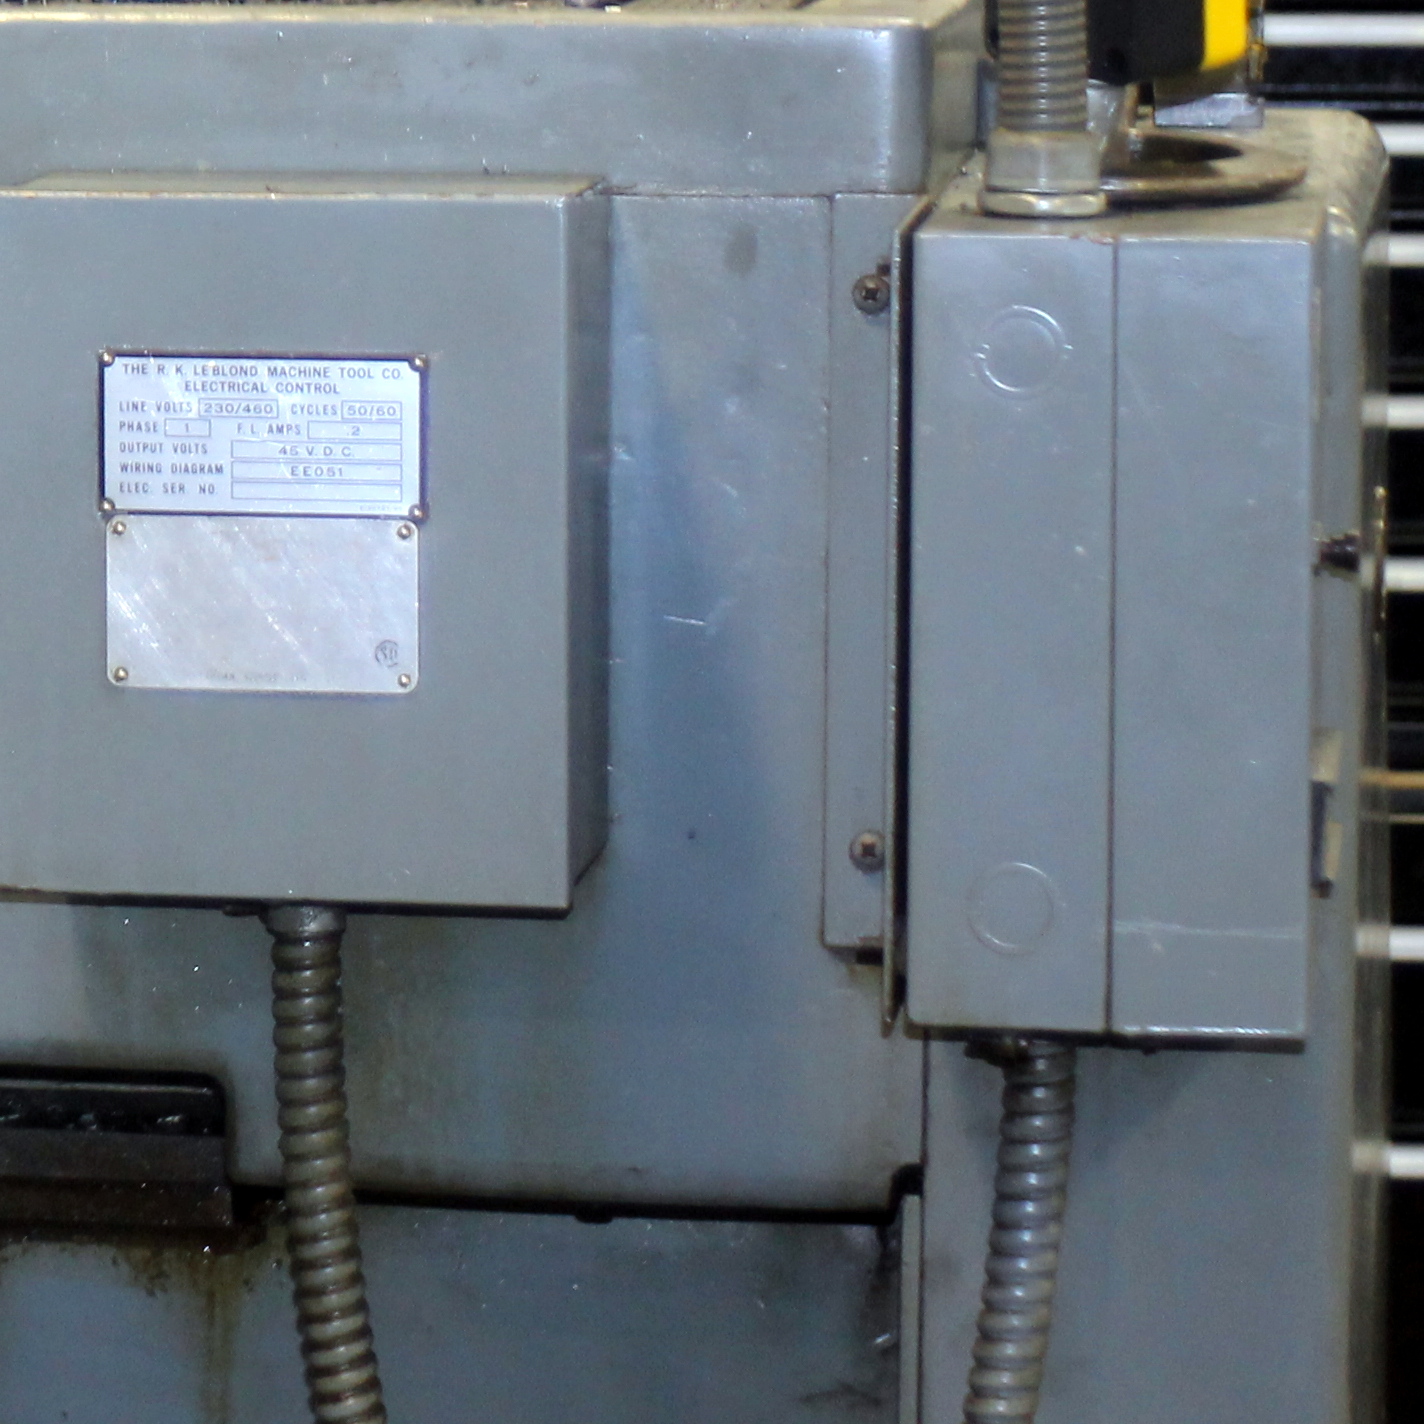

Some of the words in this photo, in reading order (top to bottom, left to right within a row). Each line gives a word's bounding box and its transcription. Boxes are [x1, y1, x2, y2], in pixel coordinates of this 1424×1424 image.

[122, 363, 149, 375] THE
[174, 364, 187, 377] K.
[267, 366, 331, 379] MACHINE
[338, 367, 375, 379] TOOL
[382, 367, 404, 380] CO.
[184, 380, 268, 394] ELECTRICAL
[275, 382, 341, 395] CONTROL
[118, 401, 147, 413] LINE
[155, 401, 193, 414] VOLTS
[203, 402, 275, 415] 230/460
[290, 403, 339, 416] CYCLES
[346, 404, 397, 417] 50/60
[118, 420, 159, 433] PHASE
[266, 423, 301, 436] AMPS
[119, 441, 164, 454] OUTPUT
[172, 442, 208, 455] VOLTS
[278, 445, 299, 456] 45
[119, 462, 163, 474] WIRING
[170, 462, 224, 475] DIAGRAM
